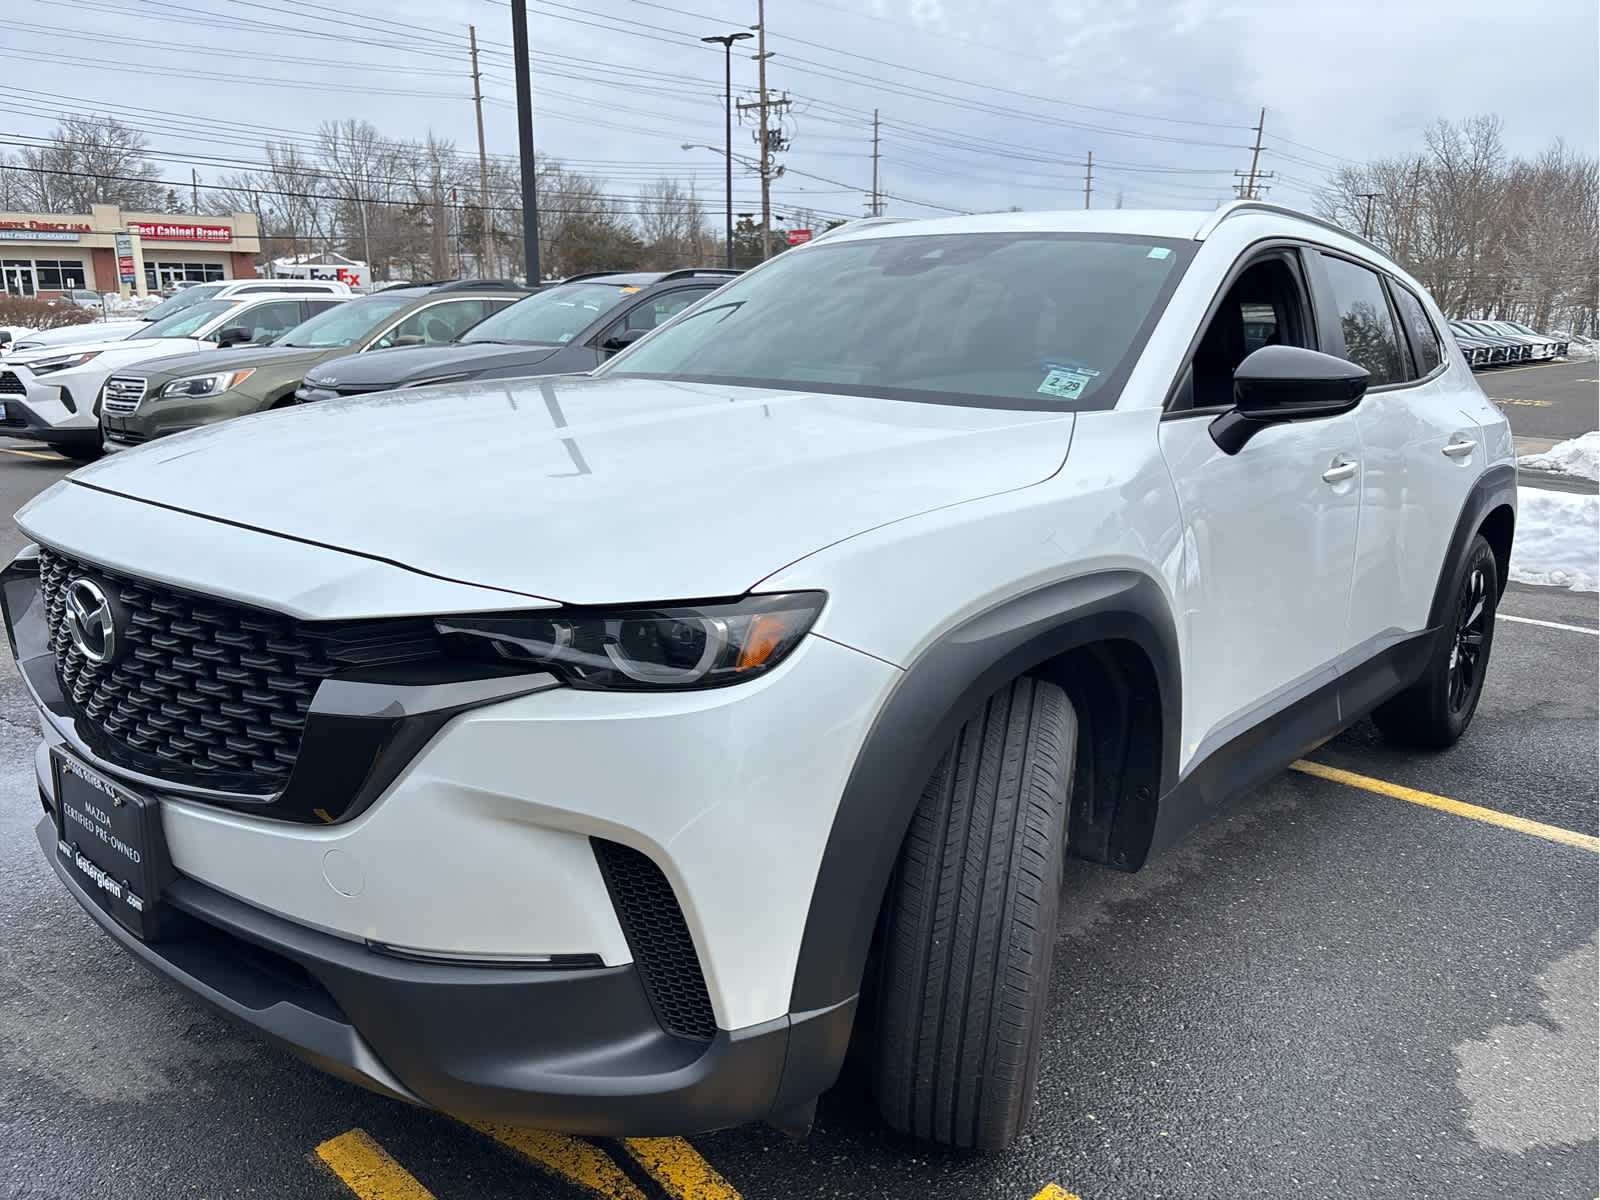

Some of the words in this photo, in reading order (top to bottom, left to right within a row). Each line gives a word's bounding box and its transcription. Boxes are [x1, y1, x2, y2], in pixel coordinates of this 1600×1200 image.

[157, 225, 194, 237] Cabinet
[196, 228, 230, 240] Brands
[310, 268, 360, 286] FedEx
[1048, 377, 1060, 387] 2
[1064, 381, 1081, 392] 29
[85, 800, 112, 828] MAZDA
[63, 802, 94, 833] CERTIFIED
[95, 825, 141, 863] PRE-OWNED
[75, 852, 121, 898] lesterglenn
